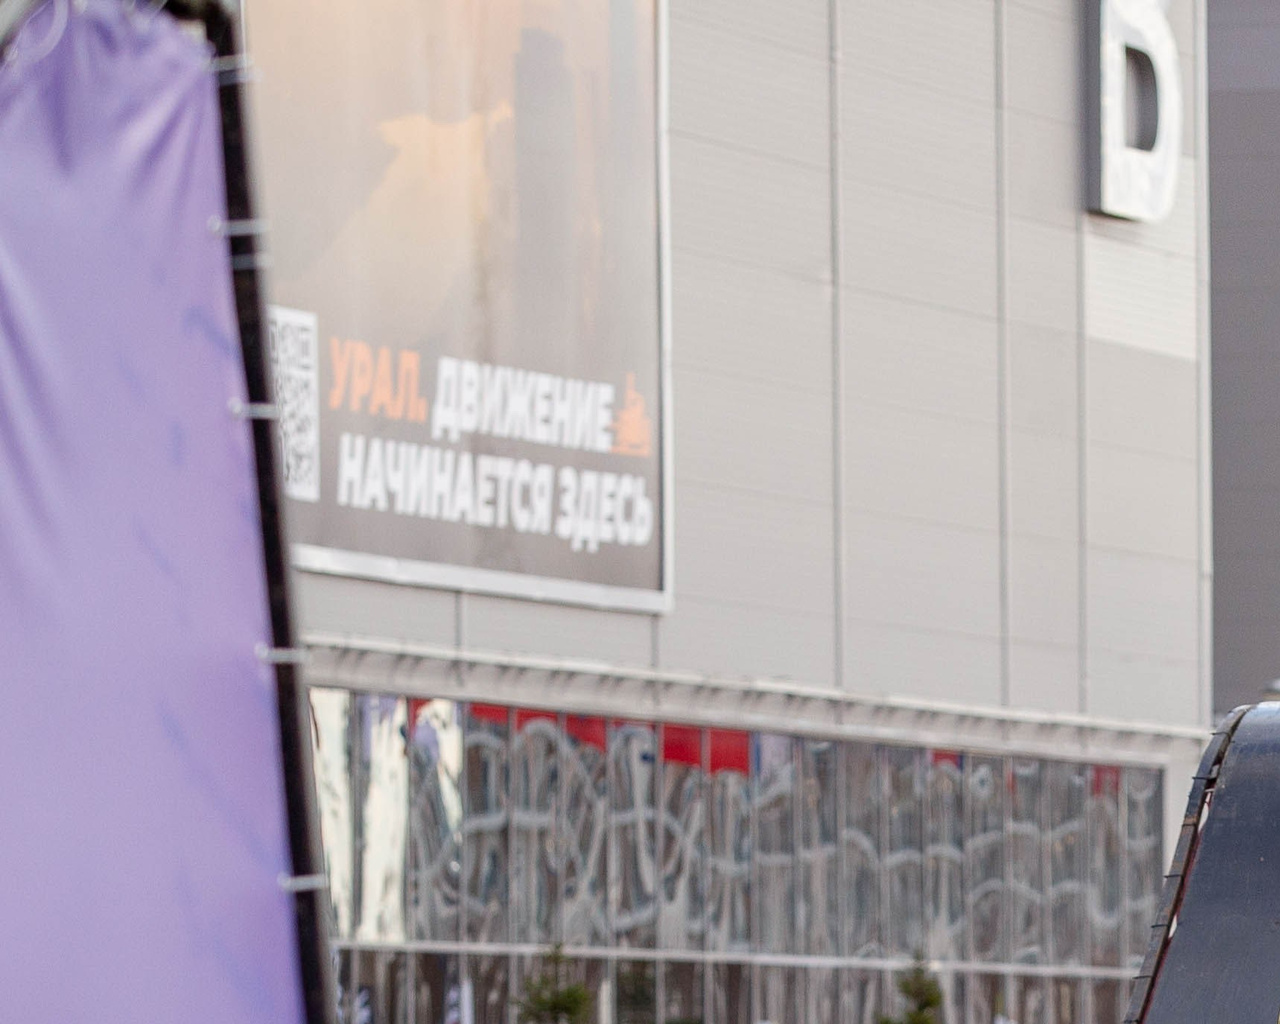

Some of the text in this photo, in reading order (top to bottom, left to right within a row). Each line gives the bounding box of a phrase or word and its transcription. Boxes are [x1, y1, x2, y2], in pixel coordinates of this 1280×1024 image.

[329, 337, 616, 454] УРАЛ. ДВИЖЕНИЕ
[336, 432, 653, 554] НАЧИНАЕТСЯ ЗДЕСЬ
